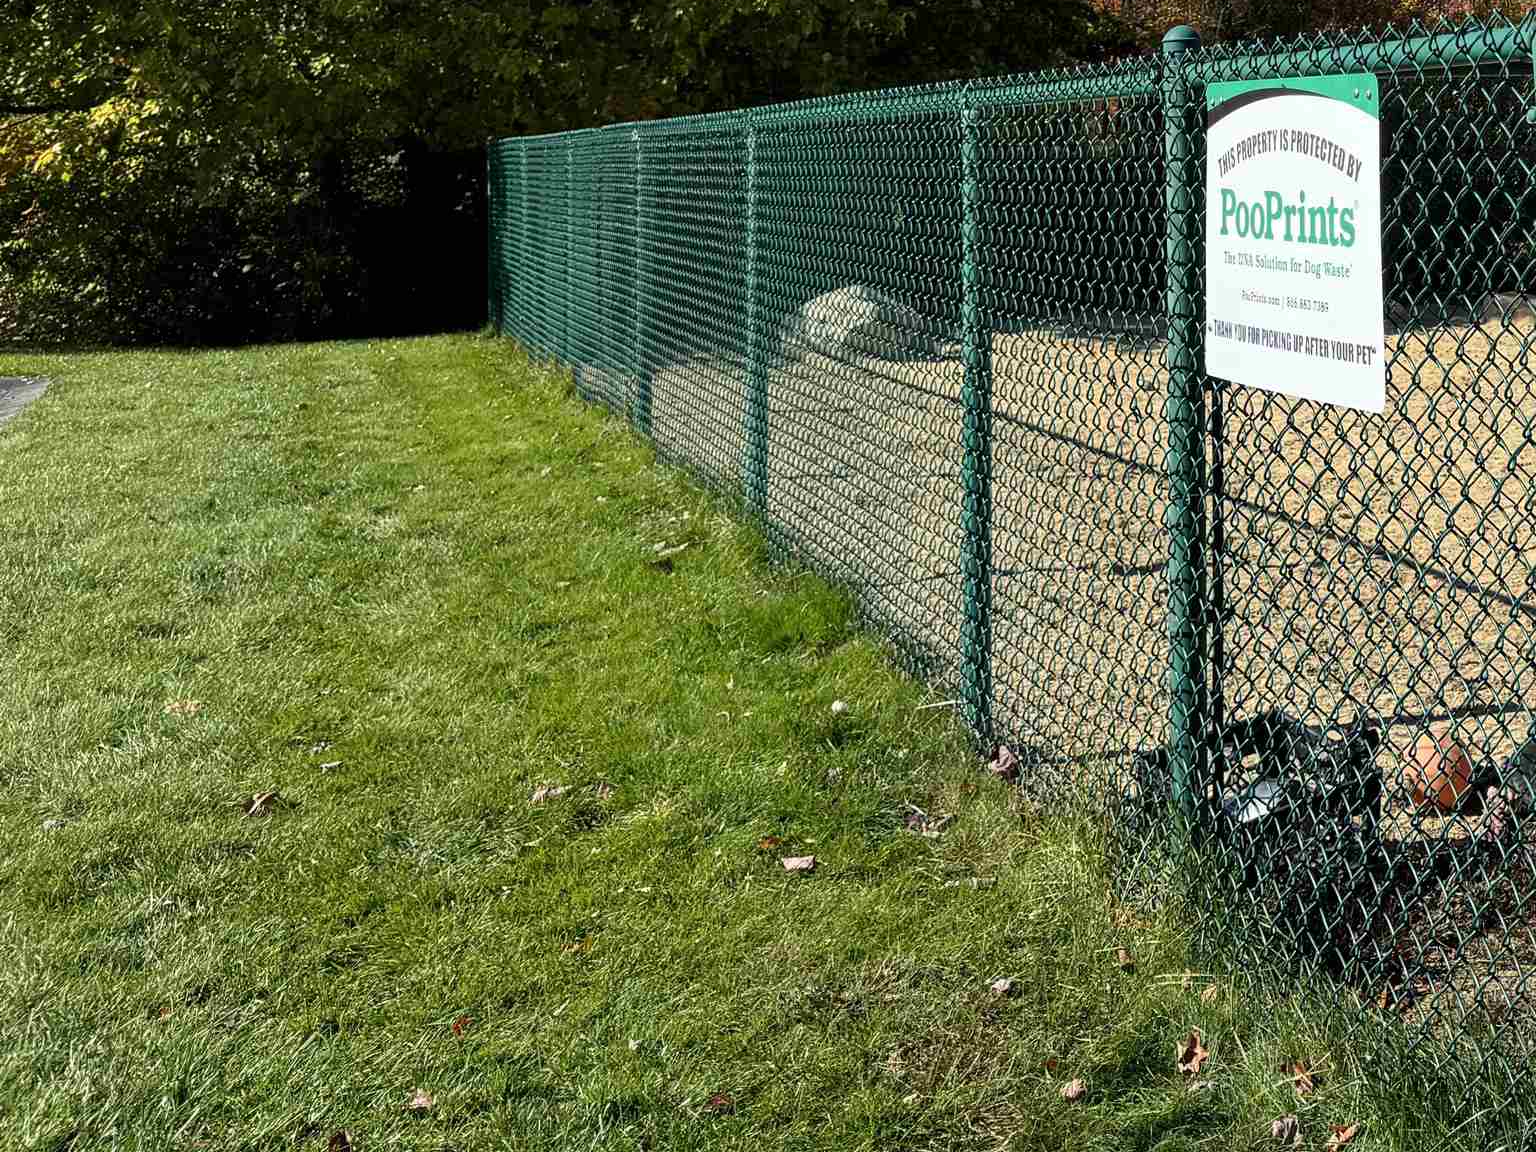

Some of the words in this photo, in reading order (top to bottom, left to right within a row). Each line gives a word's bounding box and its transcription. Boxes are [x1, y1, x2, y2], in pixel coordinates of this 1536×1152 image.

[1218, 147, 1235, 178] THIS
[1236, 129, 1278, 163] PROPERTY
[1279, 128, 1289, 151] IS
[1290, 129, 1346, 172] PROTECTED
[1346, 153, 1362, 182] BY
[1220, 188, 1356, 248] PooPrints
[1224, 250, 1236, 265] The
[1255, 254, 1288, 273] Solution
[1290, 257, 1302, 273] for
[1304, 259, 1321, 279] Dog
[1214, 319, 1232, 339] THANK
[1234, 324, 1247, 343] YOU
[1248, 326, 1260, 345] FOR
[1261, 328, 1292, 352] PICKING
[1293, 333, 1304, 353] UP
[1305, 335, 1329, 359] AFTER
[1330, 338, 1354, 363] YOUR
[1356, 344, 1373, 366] PET
